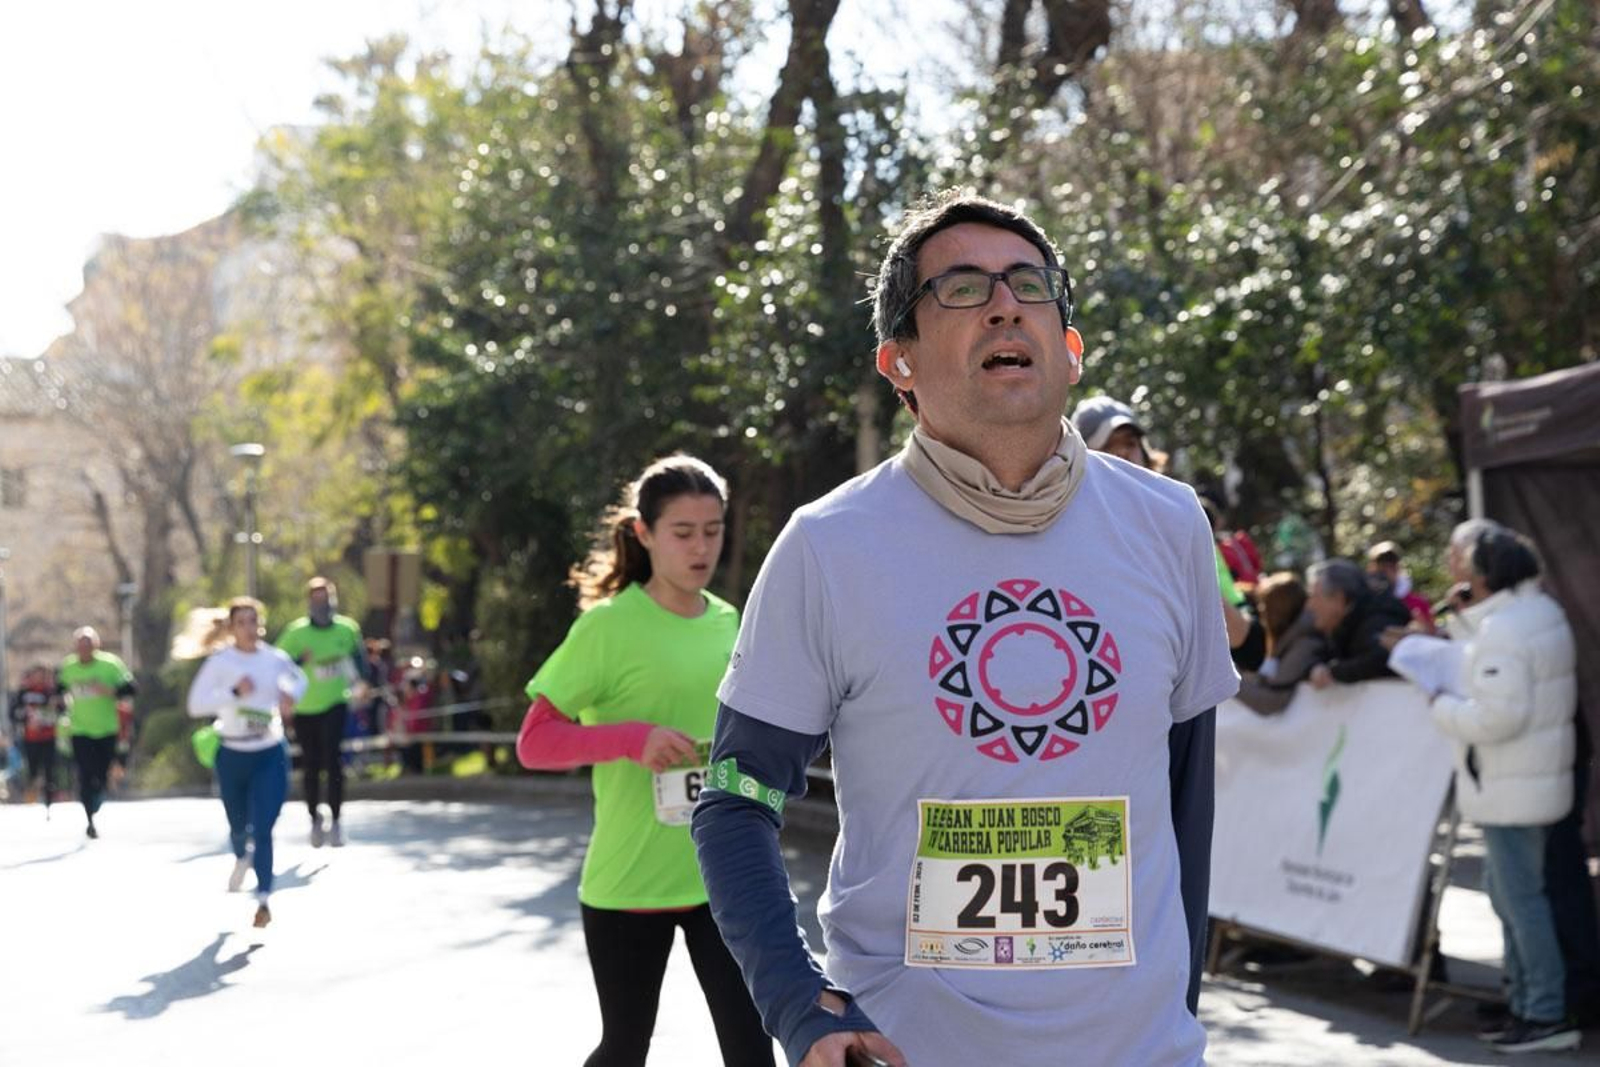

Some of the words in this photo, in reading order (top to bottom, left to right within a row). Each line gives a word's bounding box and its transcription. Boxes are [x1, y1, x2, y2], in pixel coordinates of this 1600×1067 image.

[685, 770, 707, 802] 6
[947, 808, 973, 829] SAN
[978, 808, 1016, 828] JUAN
[1021, 807, 1061, 827] BOSCO
[938, 831, 992, 854] CARRERA
[997, 829, 1052, 854] POPULAR
[956, 861, 1079, 928] 243
[1064, 940, 1087, 950] daño
[1088, 939, 1124, 949] cerebral
